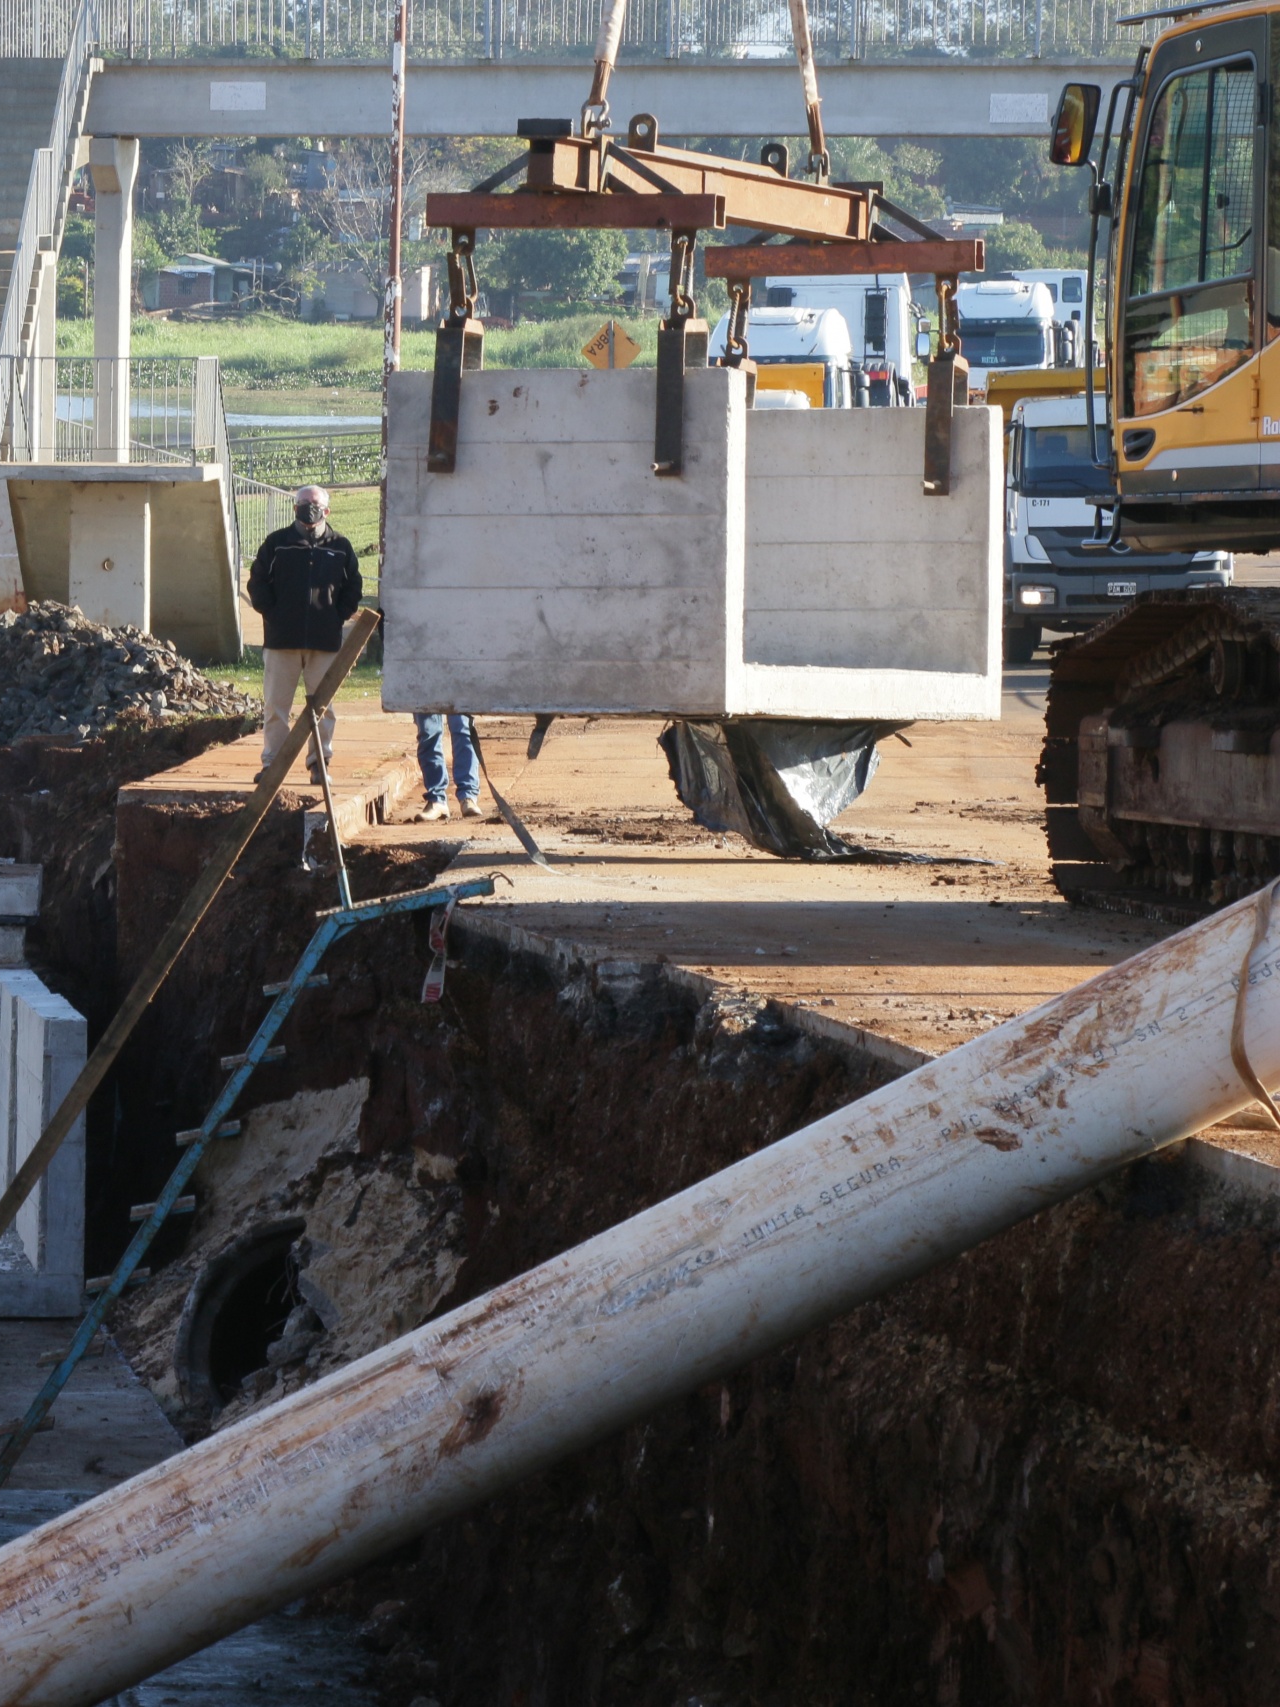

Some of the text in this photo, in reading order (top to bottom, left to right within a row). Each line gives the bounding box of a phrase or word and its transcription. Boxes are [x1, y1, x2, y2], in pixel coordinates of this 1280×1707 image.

[1263, 416, 1280, 436] Ro
[1031, 499, 1050, 507] C-171
[817, 1155, 901, 1207] SEGURA
[940, 1112, 983, 1143] PVC
